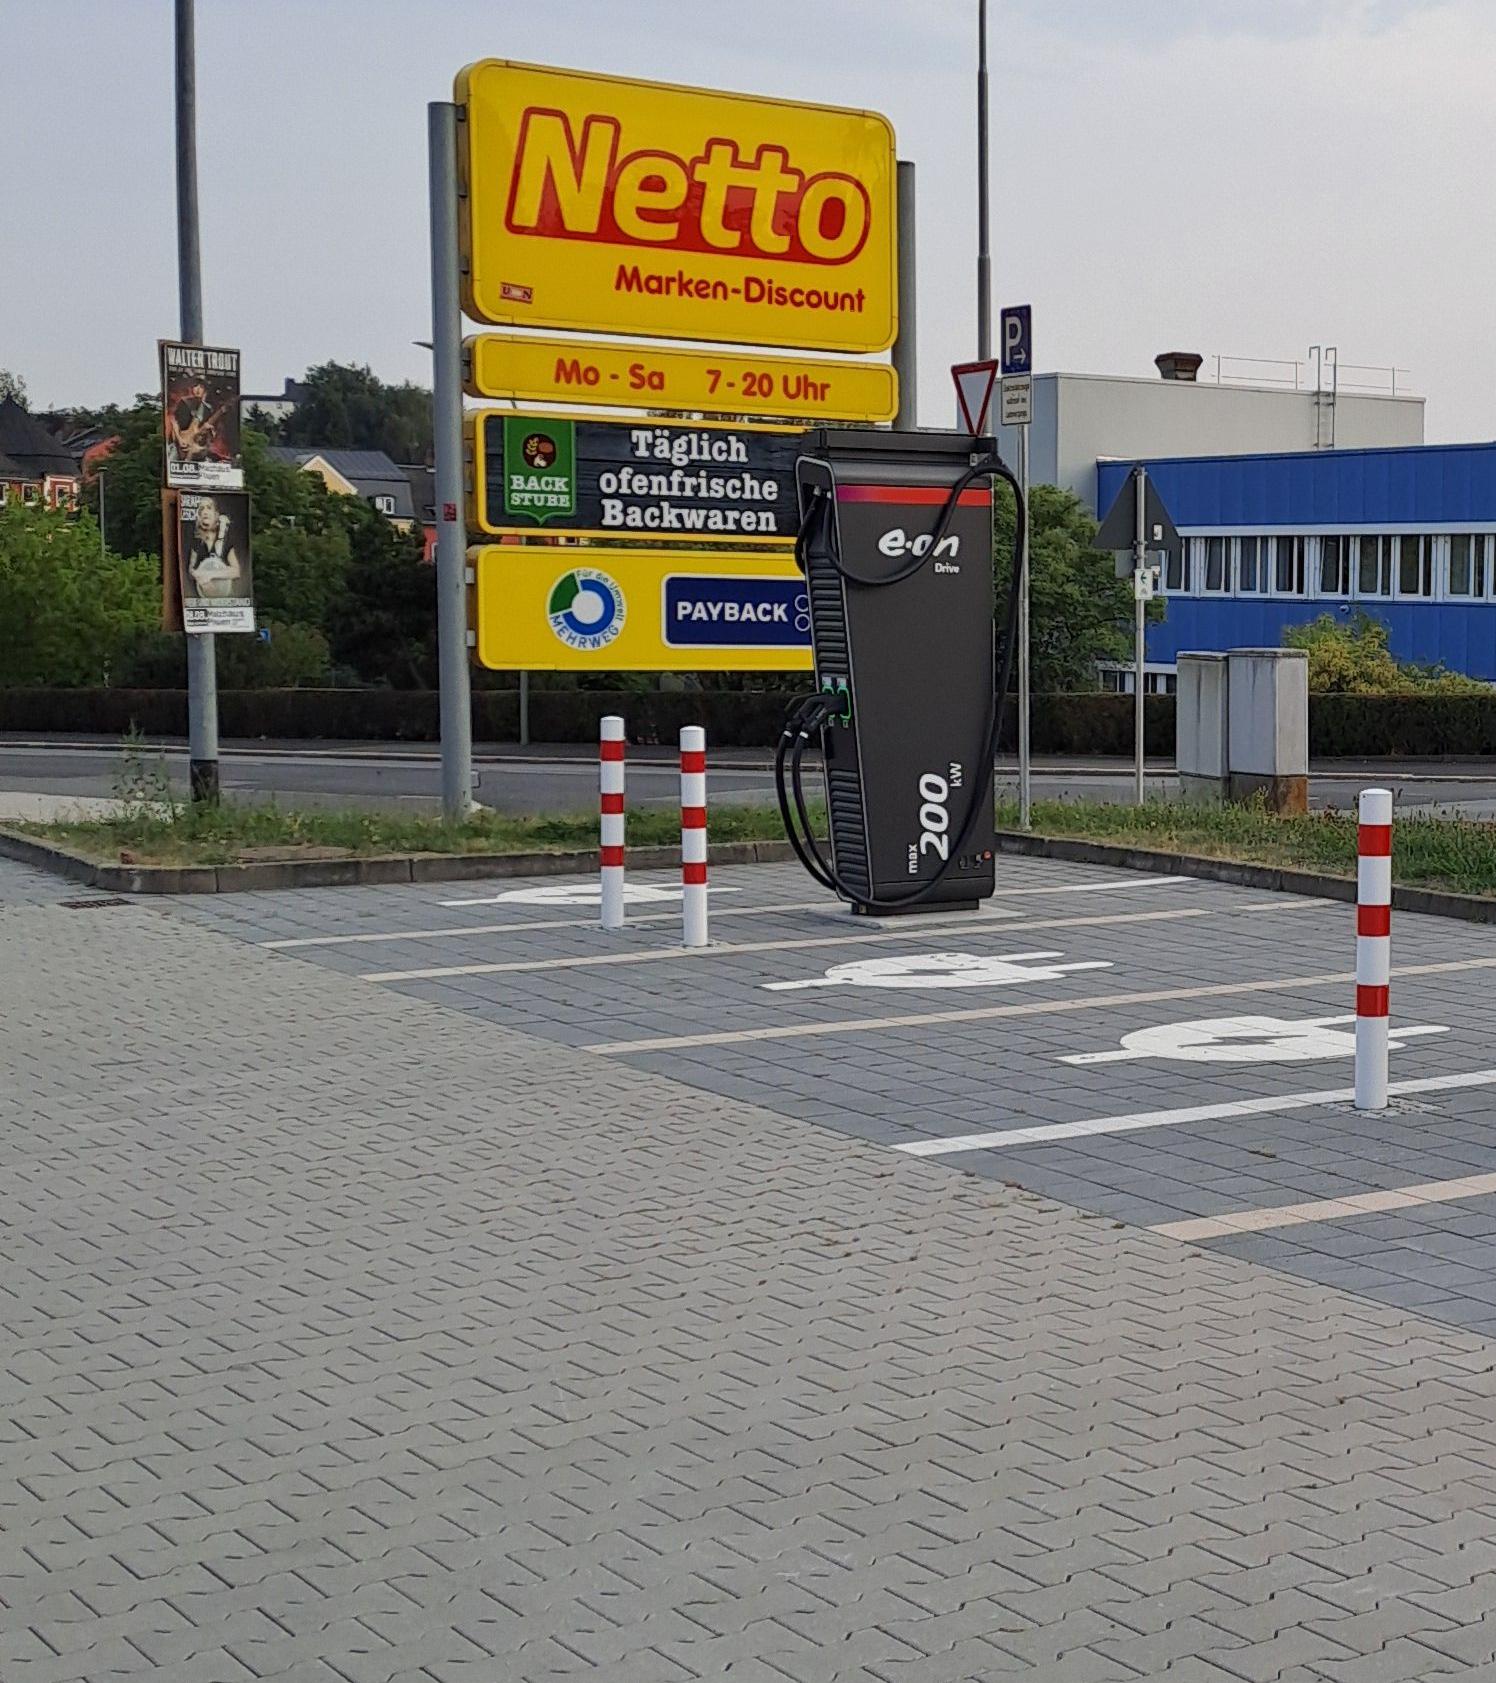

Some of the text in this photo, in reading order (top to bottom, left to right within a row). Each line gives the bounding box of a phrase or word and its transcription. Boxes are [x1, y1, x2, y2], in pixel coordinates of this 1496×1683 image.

[505, 106, 871, 266] Netto
[614, 264, 865, 313] Marken-Discount
[1005, 316, 1022, 366] P
[167, 348, 205, 369] WALTER
[205, 351, 238, 372] TROUT
[554, 357, 600, 386] Mo
[628, 363, 665, 391] Sa
[782, 374, 832, 402] Uhr
[630, 428, 749, 467] Täglich
[509, 474, 570, 493] BACK
[510, 491, 571, 508] STUBE
[599, 466, 779, 501] ofenfrische
[600, 498, 778, 532] Backwaren
[934, 562, 960, 574] Drive
[676, 601, 789, 622] PAYBACK
[549, 614, 620, 649] MEHRWEG
[949, 762, 962, 787] kW
[919, 773, 949, 861] 200
[908, 843, 918, 874] max
